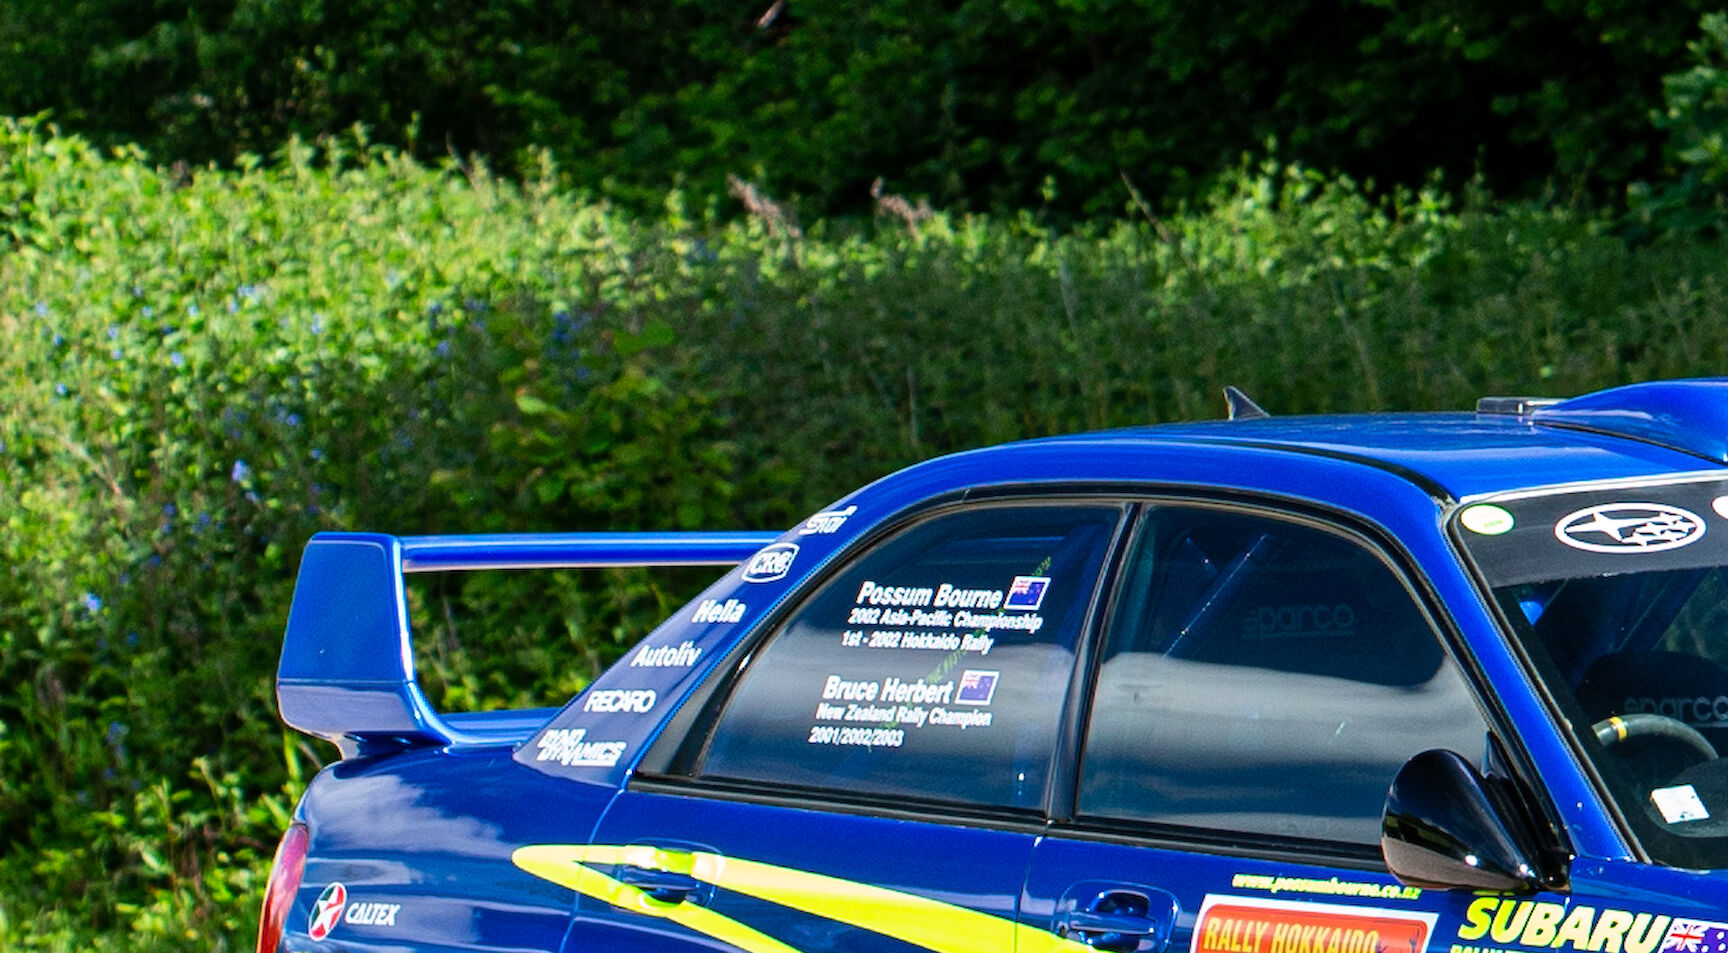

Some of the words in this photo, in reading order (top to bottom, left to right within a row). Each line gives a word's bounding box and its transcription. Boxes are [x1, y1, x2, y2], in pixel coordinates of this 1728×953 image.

[748, 551, 793, 574] CRC
[856, 581, 933, 605] Possum
[934, 584, 1003, 609] Bourne
[692, 599, 747, 624] Hella
[848, 608, 880, 626] 2002
[880, 609, 952, 628] Asia-Pacific
[953, 611, 1044, 634] Championship
[630, 640, 702, 668] Autoliv
[842, 630, 863, 648] 1st
[869, 631, 900, 648] 2002
[900, 632, 960, 651] Hokkaido
[961, 634, 994, 655] Rally
[584, 690, 657, 714] RECARO
[823, 675, 879, 702] Bruce
[880, 678, 954, 704] Herbert
[816, 703, 845, 720] New
[844, 704, 899, 723] Zealand
[898, 706, 929, 728] Rally
[929, 708, 992, 730] Champion
[808, 727, 905, 748] 2001/2002/2003
[1232, 874, 1422, 900] www.possumbourne.co.nz
[344, 902, 400, 927] CALTEX
